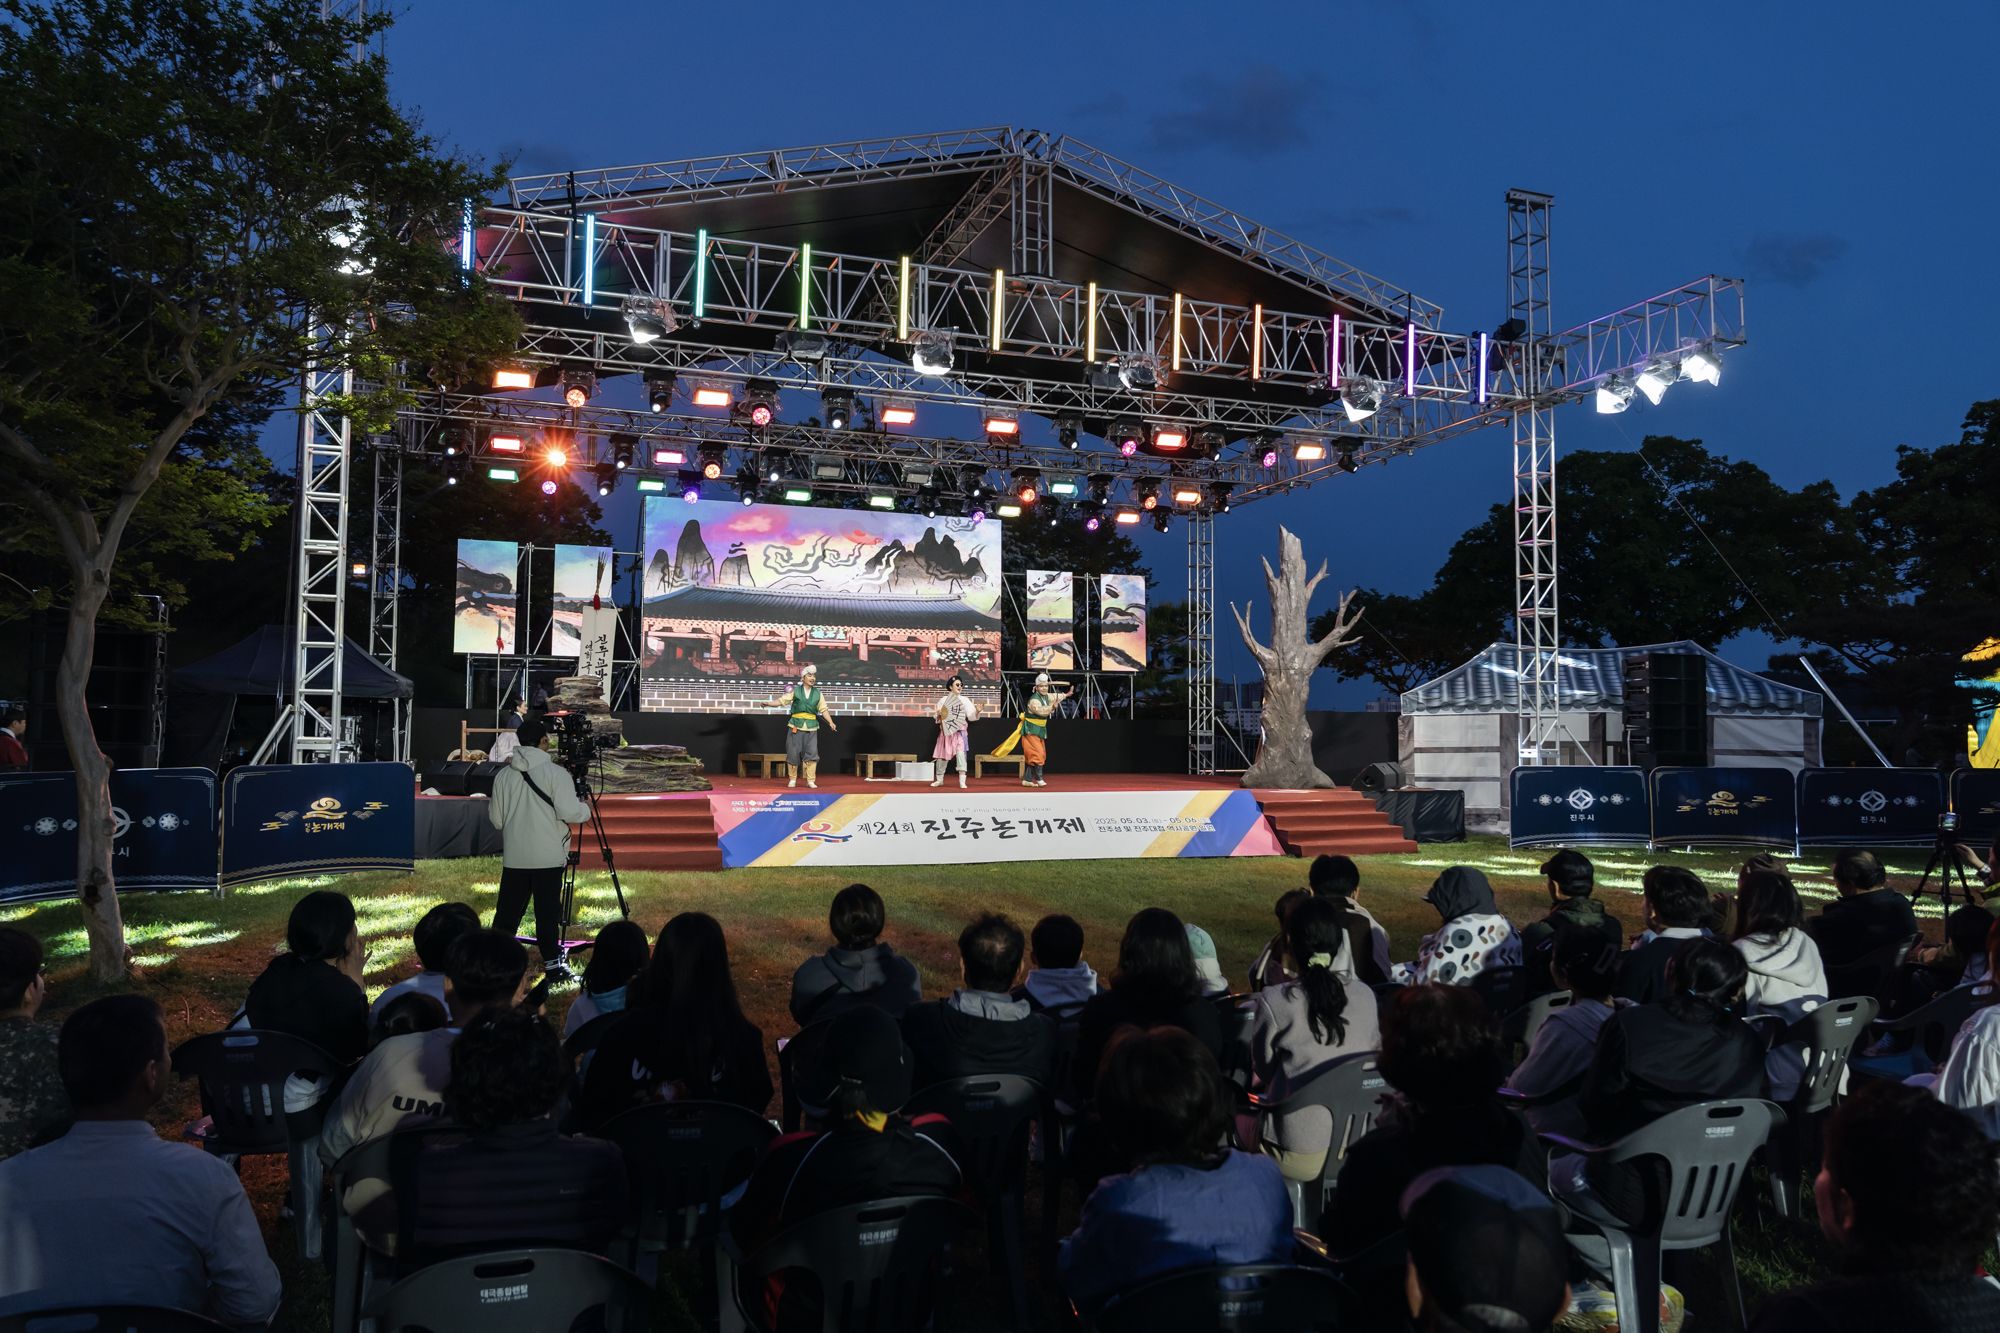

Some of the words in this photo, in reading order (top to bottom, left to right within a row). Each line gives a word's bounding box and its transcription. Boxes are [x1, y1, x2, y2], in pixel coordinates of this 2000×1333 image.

[1569, 813, 1595, 822] 진주시
[1860, 815, 1887, 824] 진주시
[311, 821, 346, 833] 논개제
[857, 821, 916, 835] 제24회
[920, 816, 1086, 840] 진주논개제
[1098, 825, 1123, 833] 진주성
[480, 1283, 529, 1299] 태극종합렌탈
